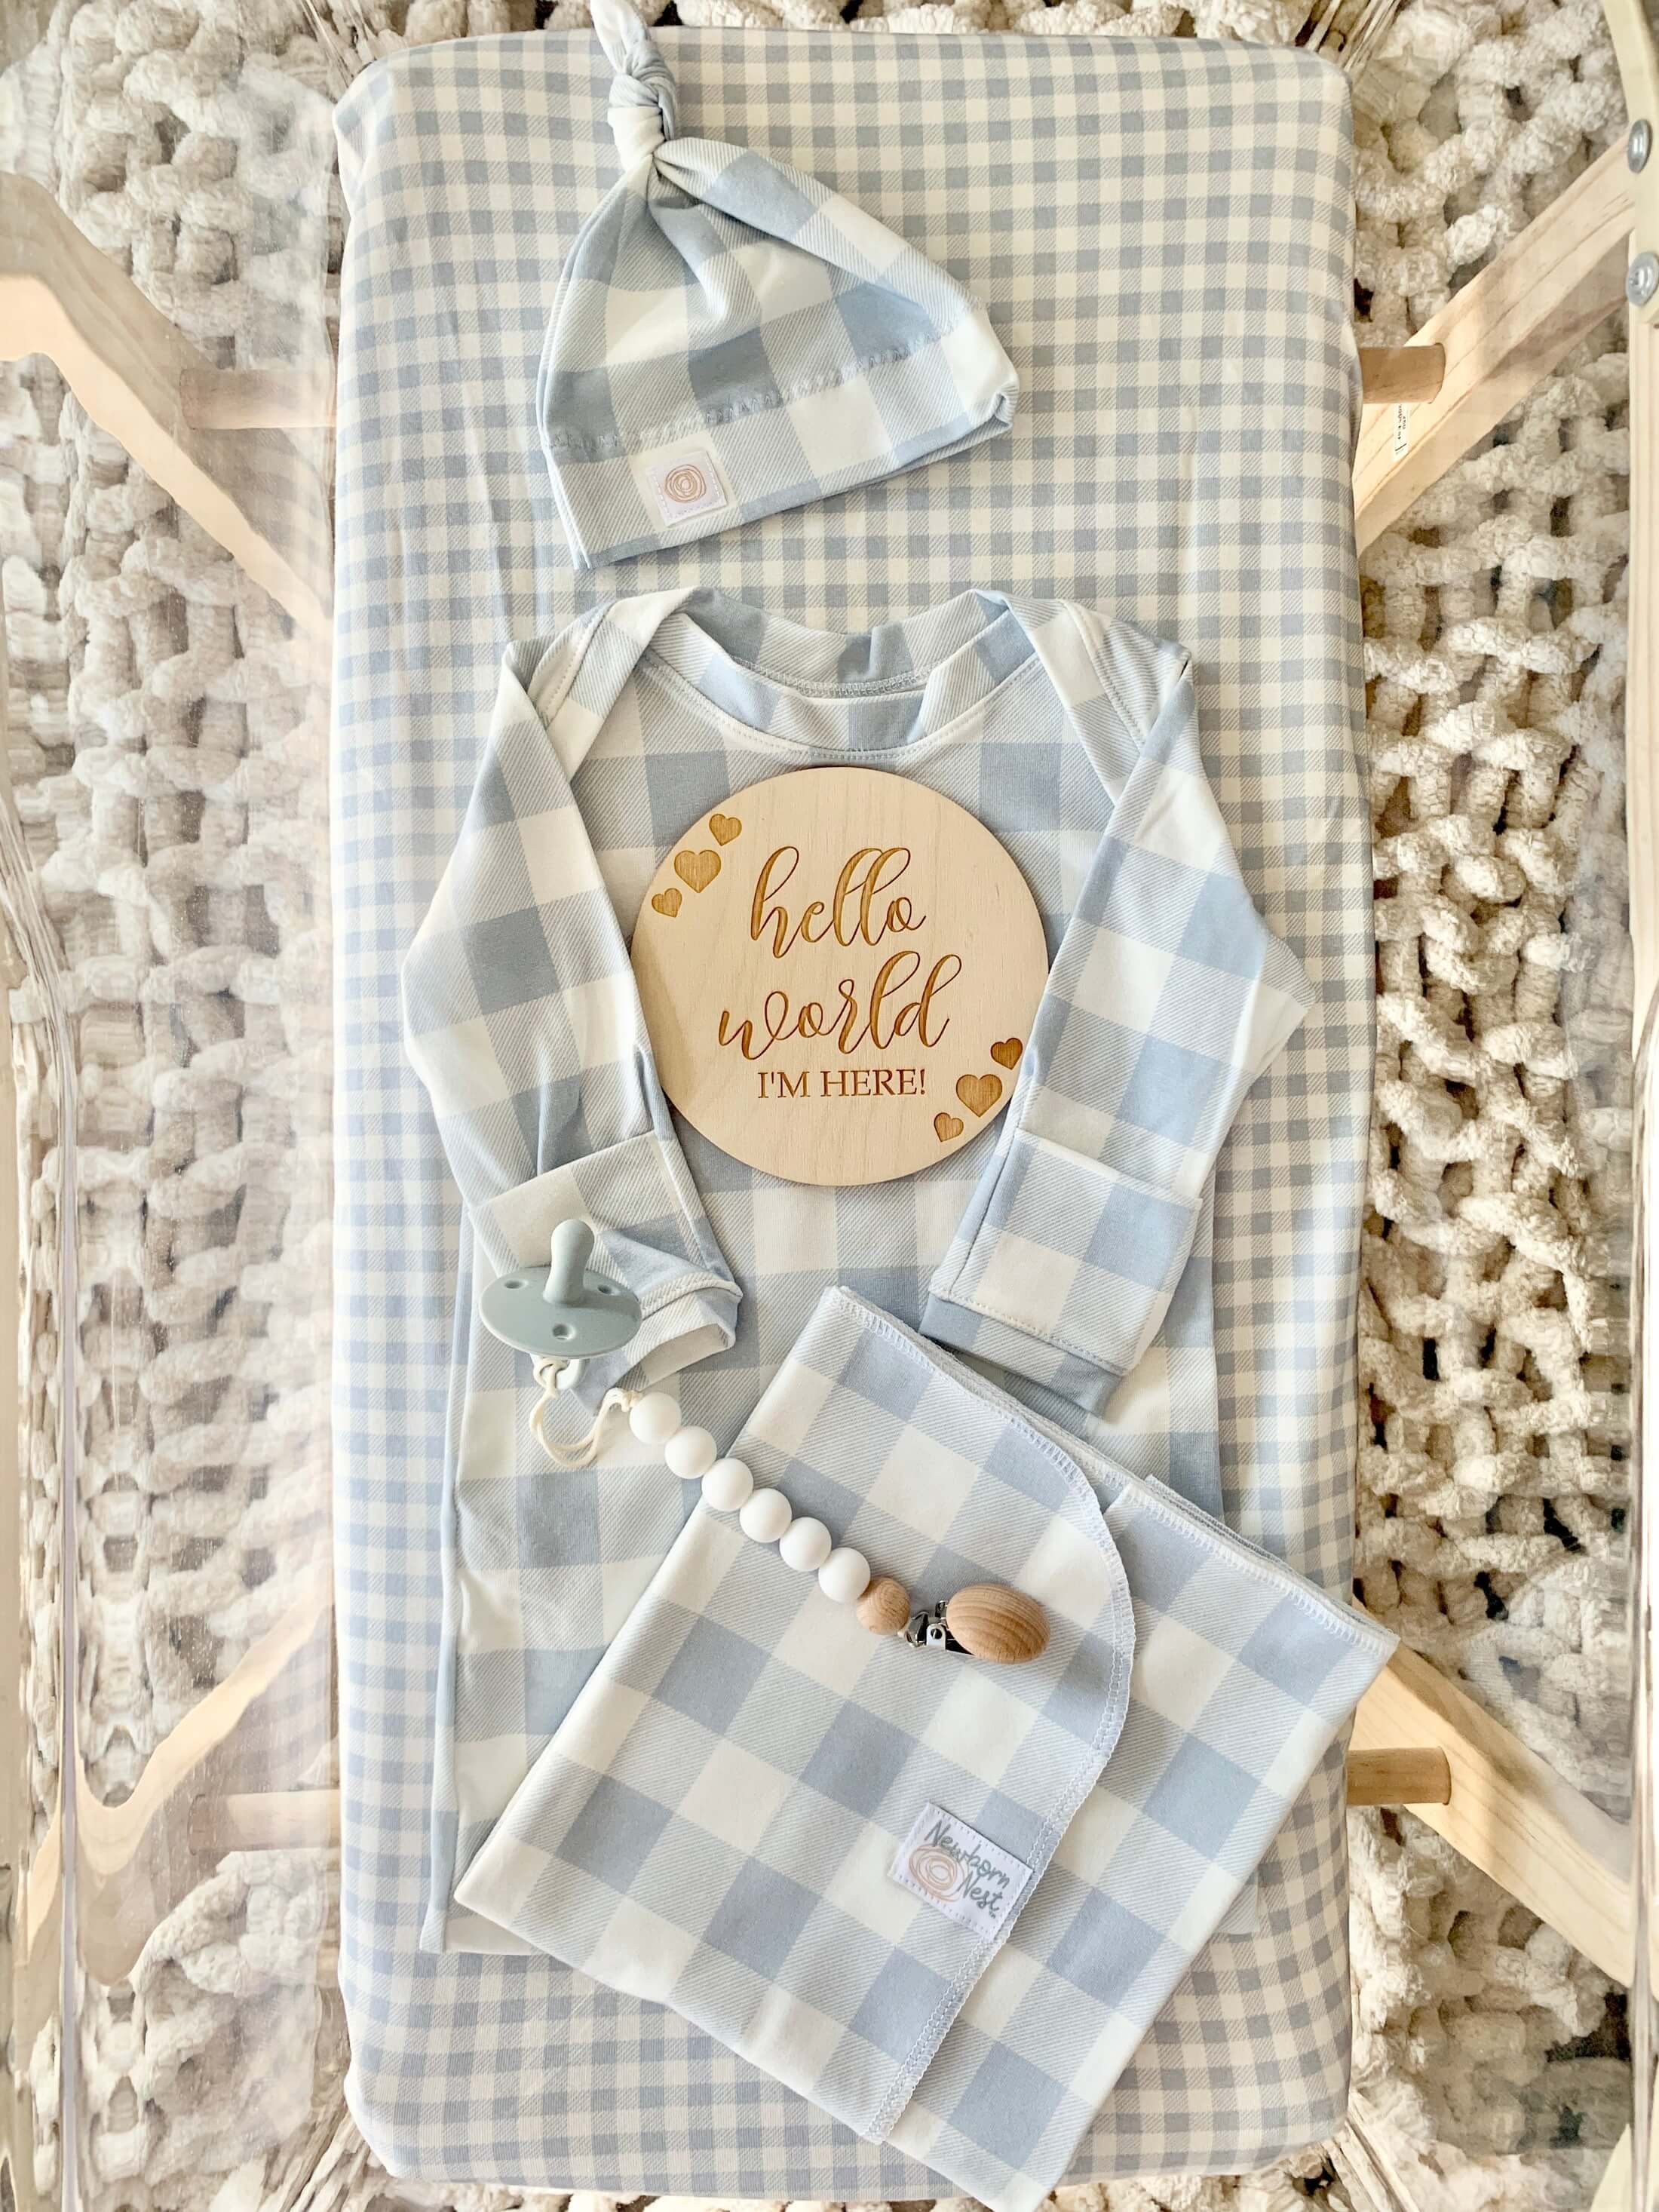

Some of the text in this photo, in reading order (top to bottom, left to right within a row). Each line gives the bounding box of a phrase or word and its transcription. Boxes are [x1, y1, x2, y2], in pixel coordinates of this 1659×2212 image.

[750, 845, 927, 959] hello
[719, 950, 963, 1060] world
[757, 1069, 927, 1099] I'M HERE!
[924, 1820, 1010, 1888] Newborn
[957, 1870, 1004, 1910] Nest
